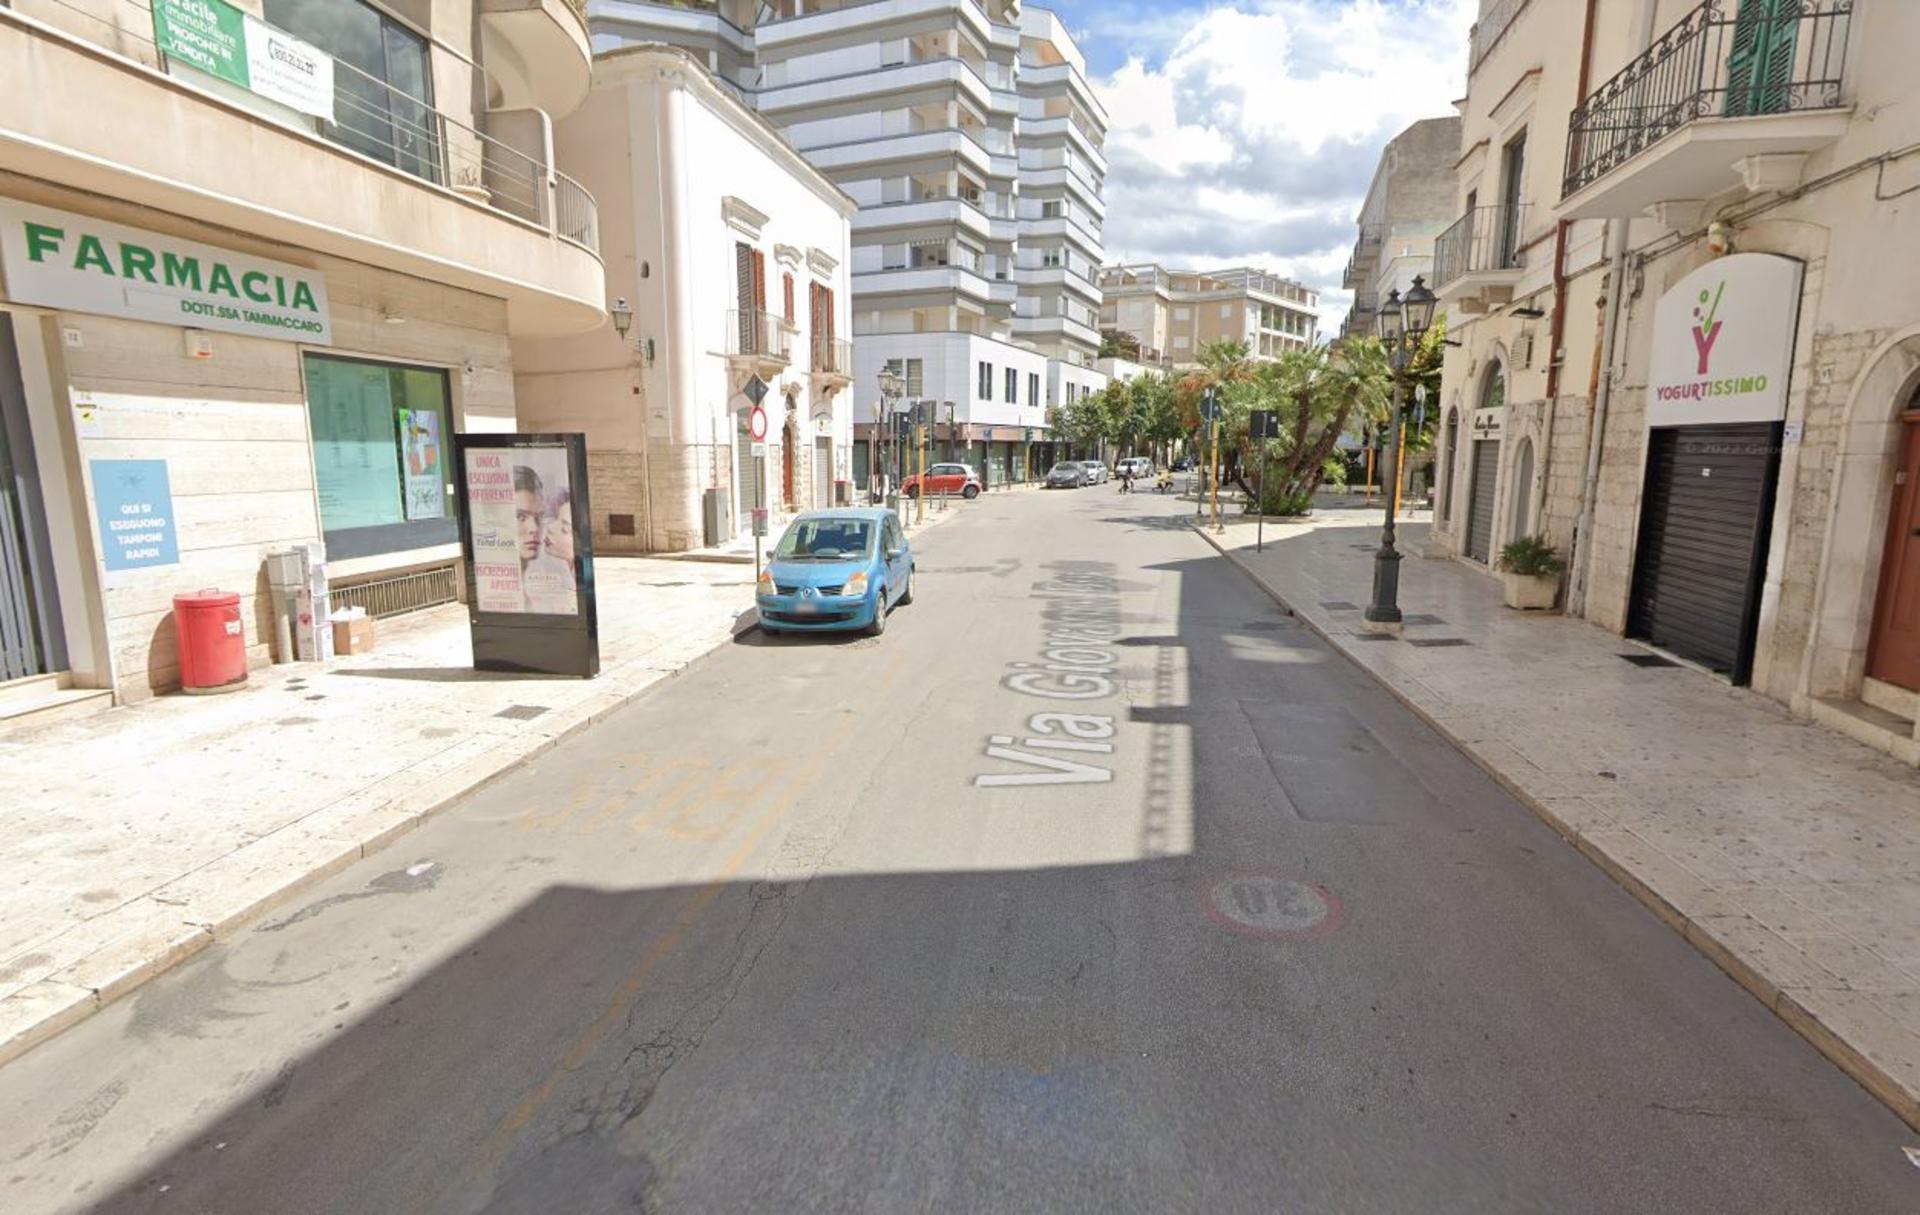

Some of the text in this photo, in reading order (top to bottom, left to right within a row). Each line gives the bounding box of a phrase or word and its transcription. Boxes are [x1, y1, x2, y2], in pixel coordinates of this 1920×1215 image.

[171, 0, 218, 25] acile
[167, 20, 220, 55] PROPONE
[168, 36, 217, 70] VENDITA
[24, 221, 319, 313] FARMACIA
[243, 309, 324, 334] TAMMACCARO
[1656, 375, 1768, 401] YOGURTISSIMO
[476, 456, 500, 468] UNICA
[122, 504, 140, 514] QUI
[110, 518, 165, 530] ESEGUONO
